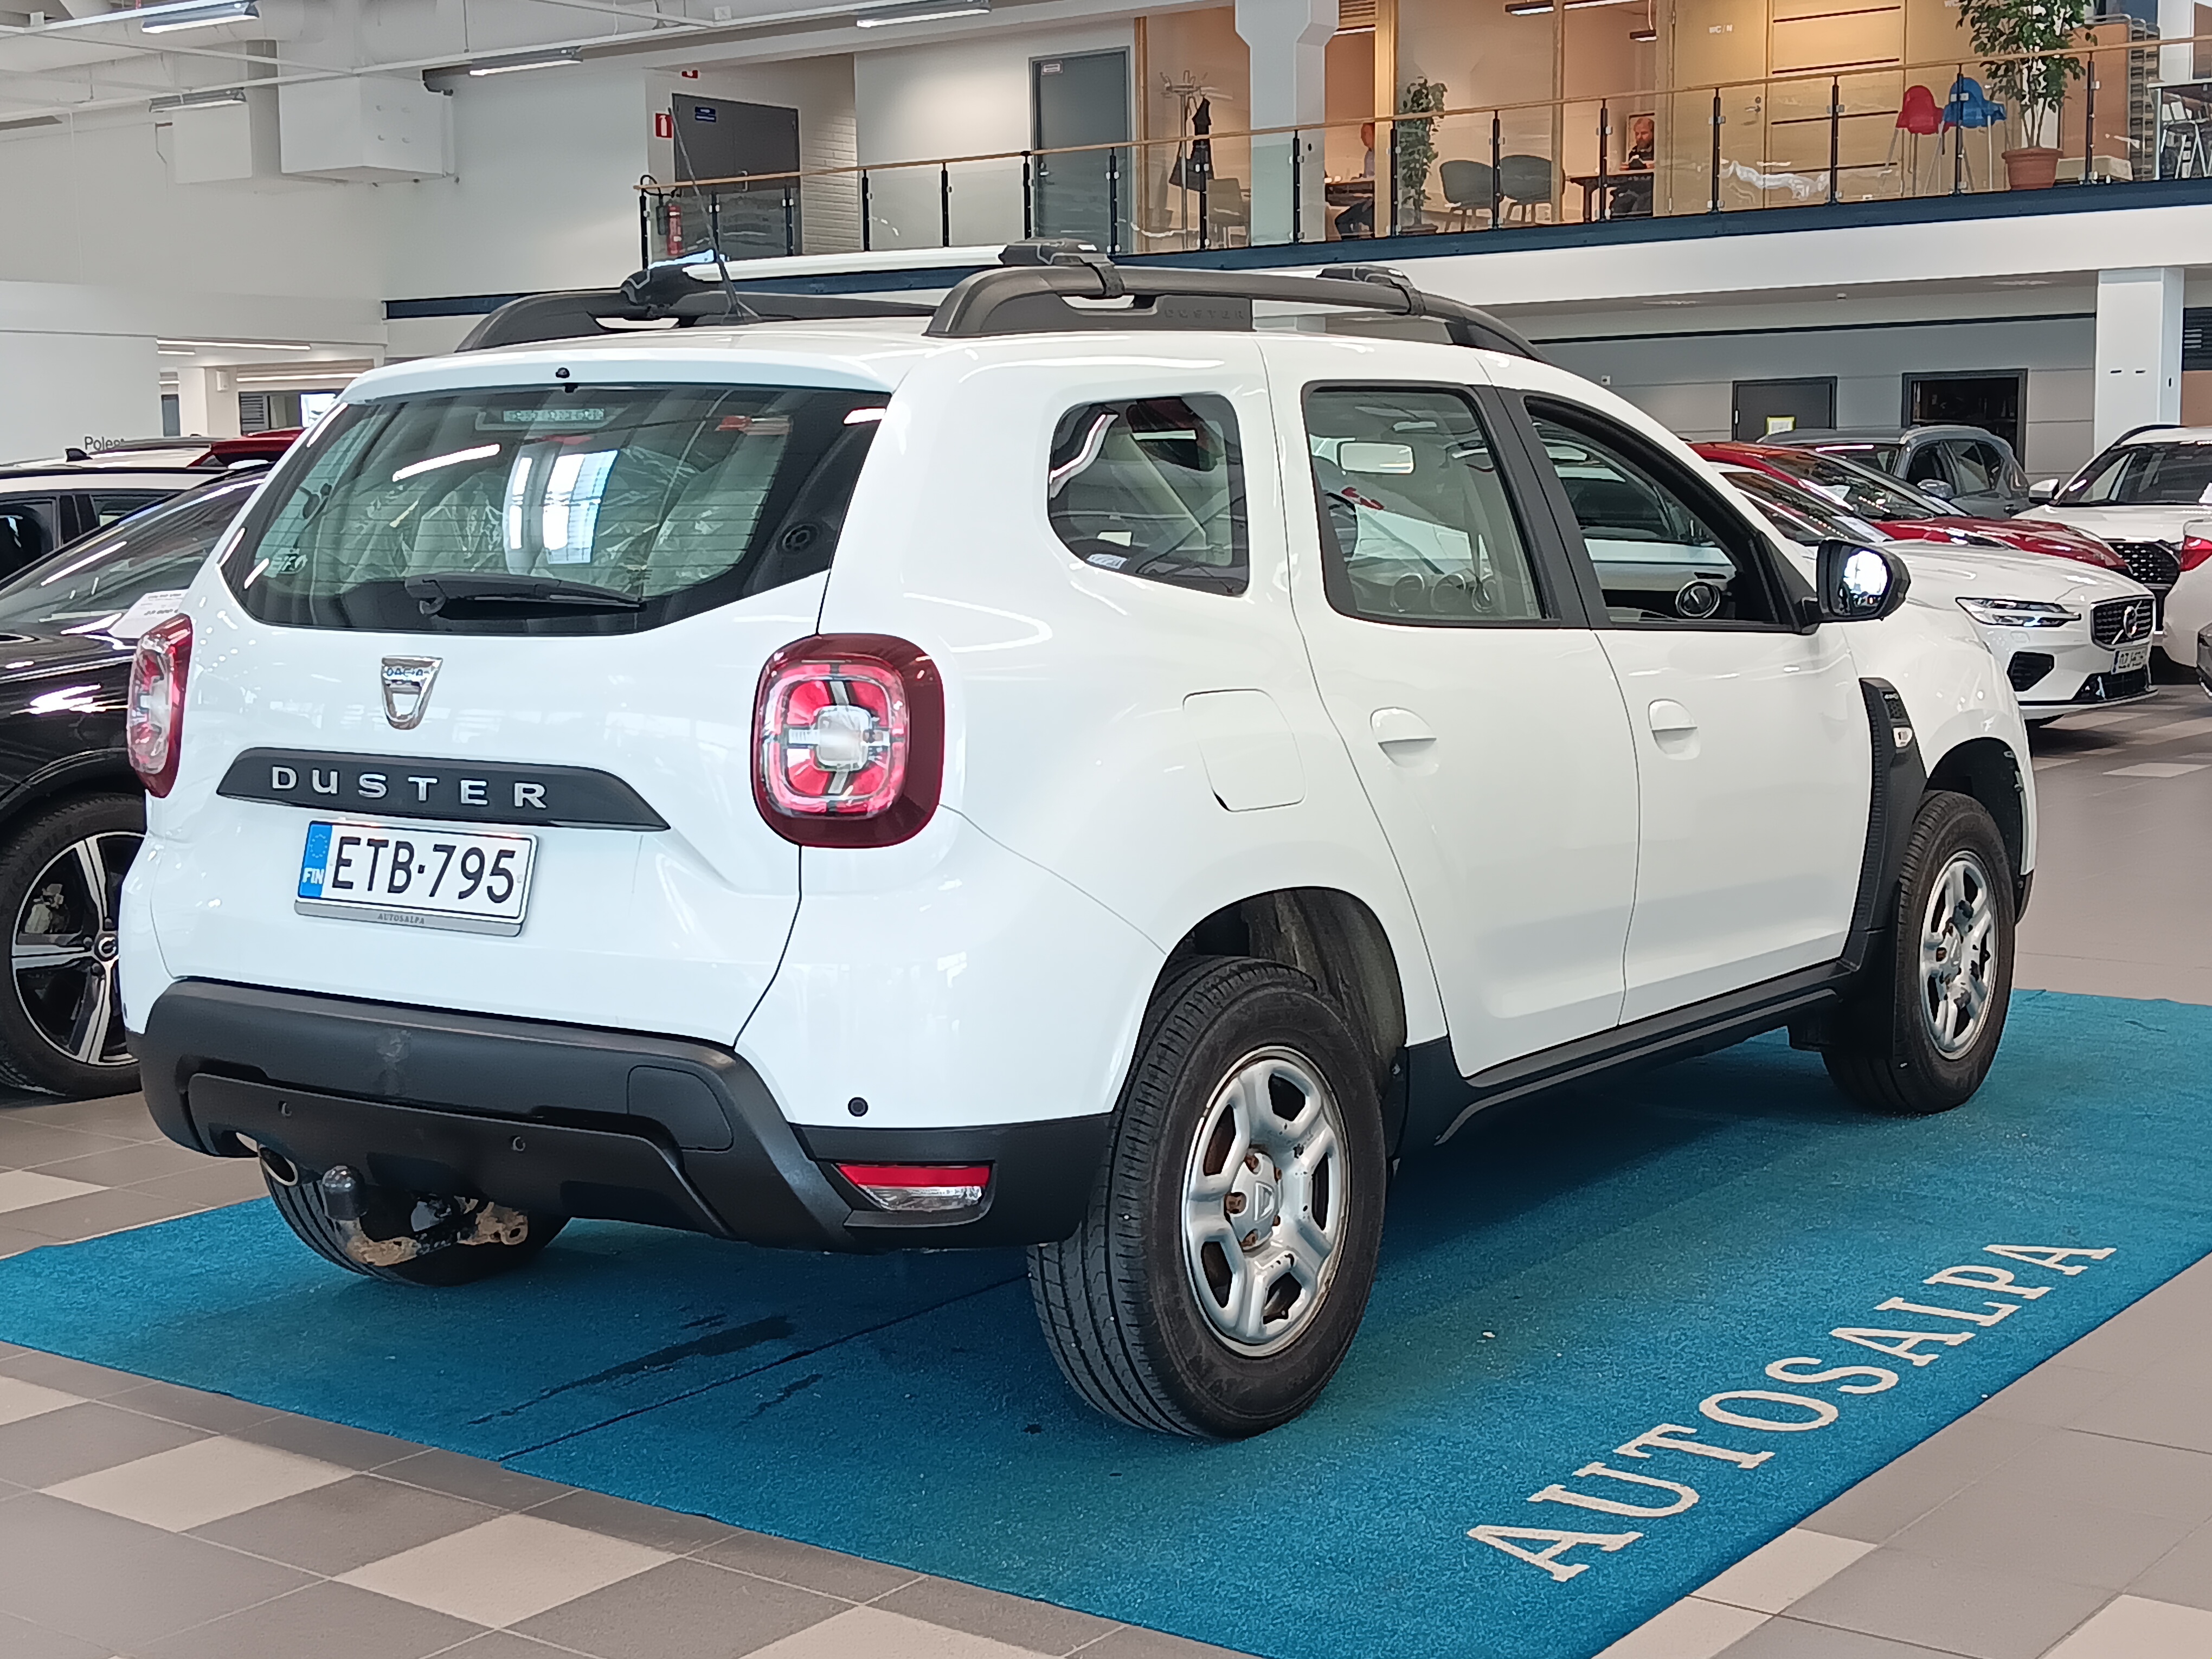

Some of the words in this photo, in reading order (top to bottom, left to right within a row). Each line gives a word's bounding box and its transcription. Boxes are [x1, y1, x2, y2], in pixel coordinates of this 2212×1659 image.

[272, 766, 547, 809] DUSTER
[303, 867, 325, 885] FIN
[332, 836, 516, 904] ETB-795
[377, 913, 425, 924] AUTOSALPA
[1467, 1244, 2117, 1583] AUTOSALPA
